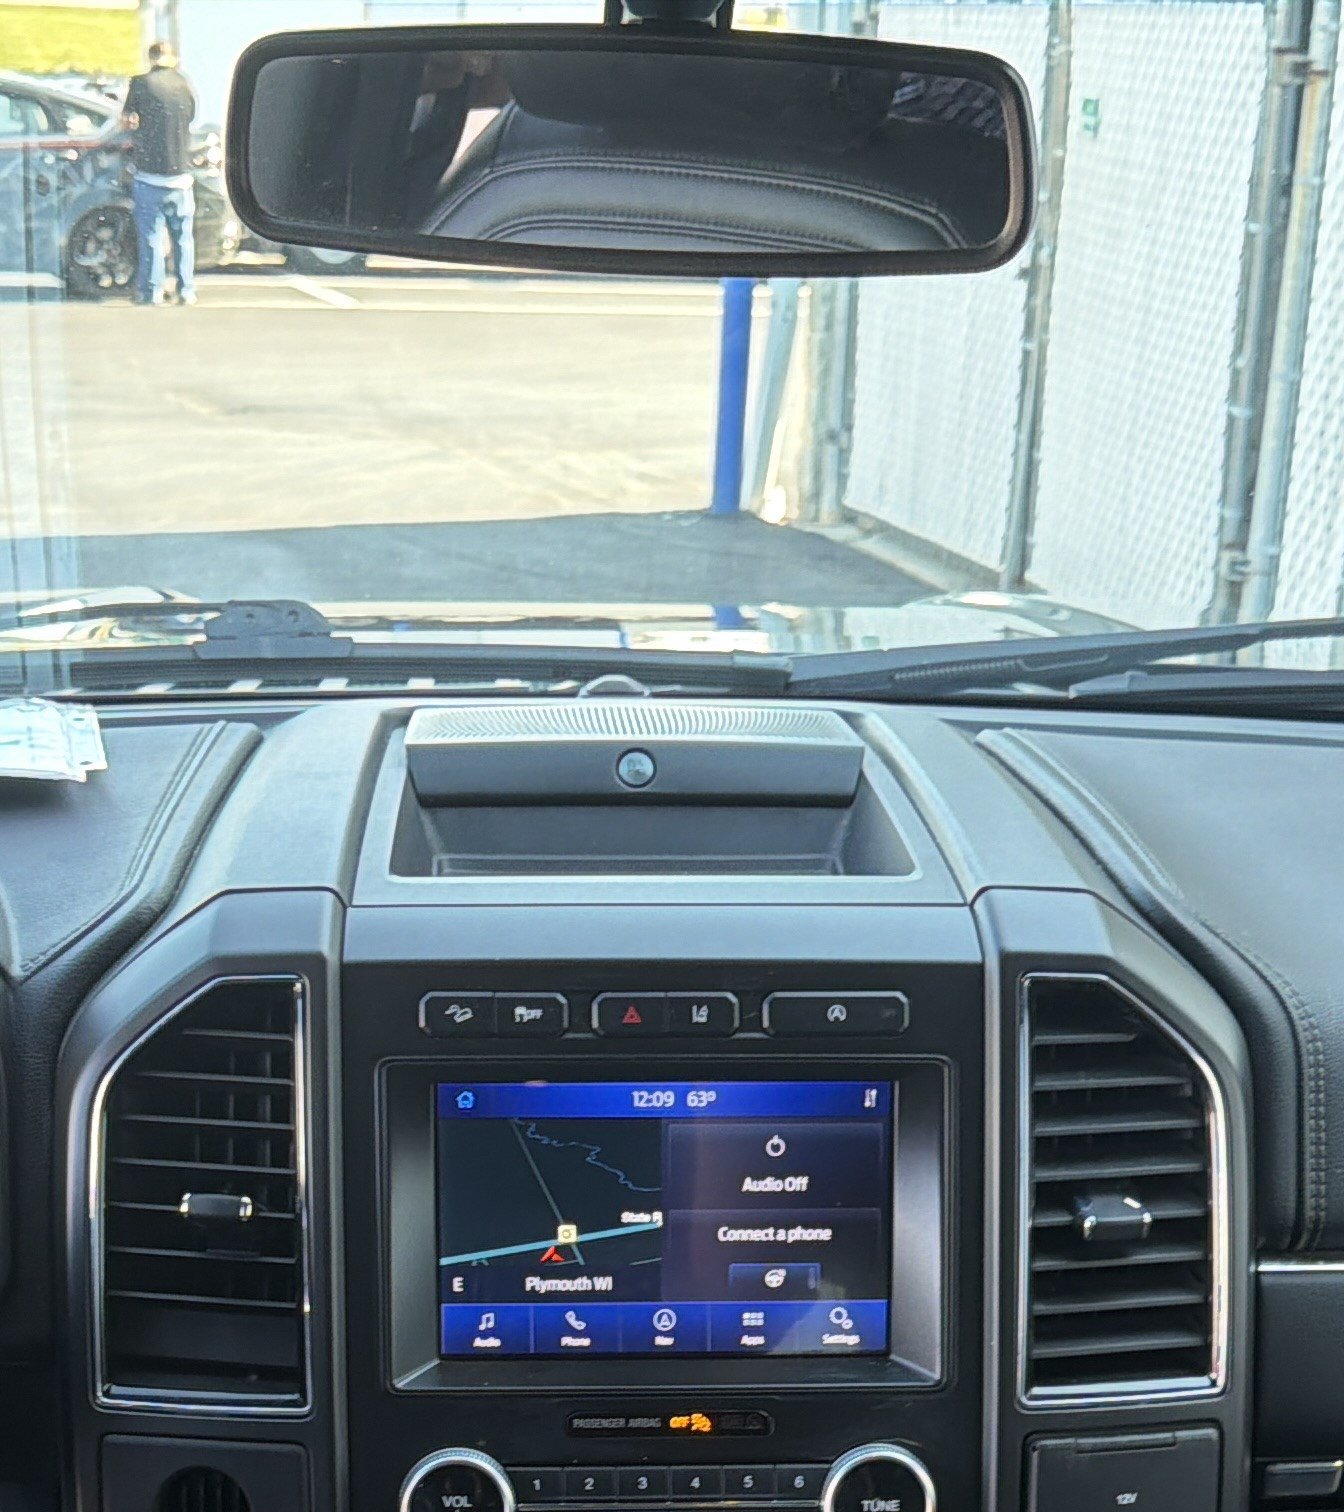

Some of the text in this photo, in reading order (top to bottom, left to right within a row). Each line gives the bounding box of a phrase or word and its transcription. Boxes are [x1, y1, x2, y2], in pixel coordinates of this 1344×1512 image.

[631, 1091, 675, 1107] 12:09
[741, 1176, 809, 1192] Audio Off
[717, 1226, 833, 1243] Connect a phone
[452, 1277, 464, 1292] E
[525, 1277, 613, 1294] Plymouth WI
[532, 1478, 541, 1491] 1
[584, 1477, 595, 1490] 2
[637, 1476, 648, 1490] 3
[689, 1476, 701, 1489] 4
[743, 1475, 754, 1488] 5
[794, 1475, 805, 1488] 6
[441, 1495, 472, 1508] VOL
[861, 1499, 901, 1512] TUNE
